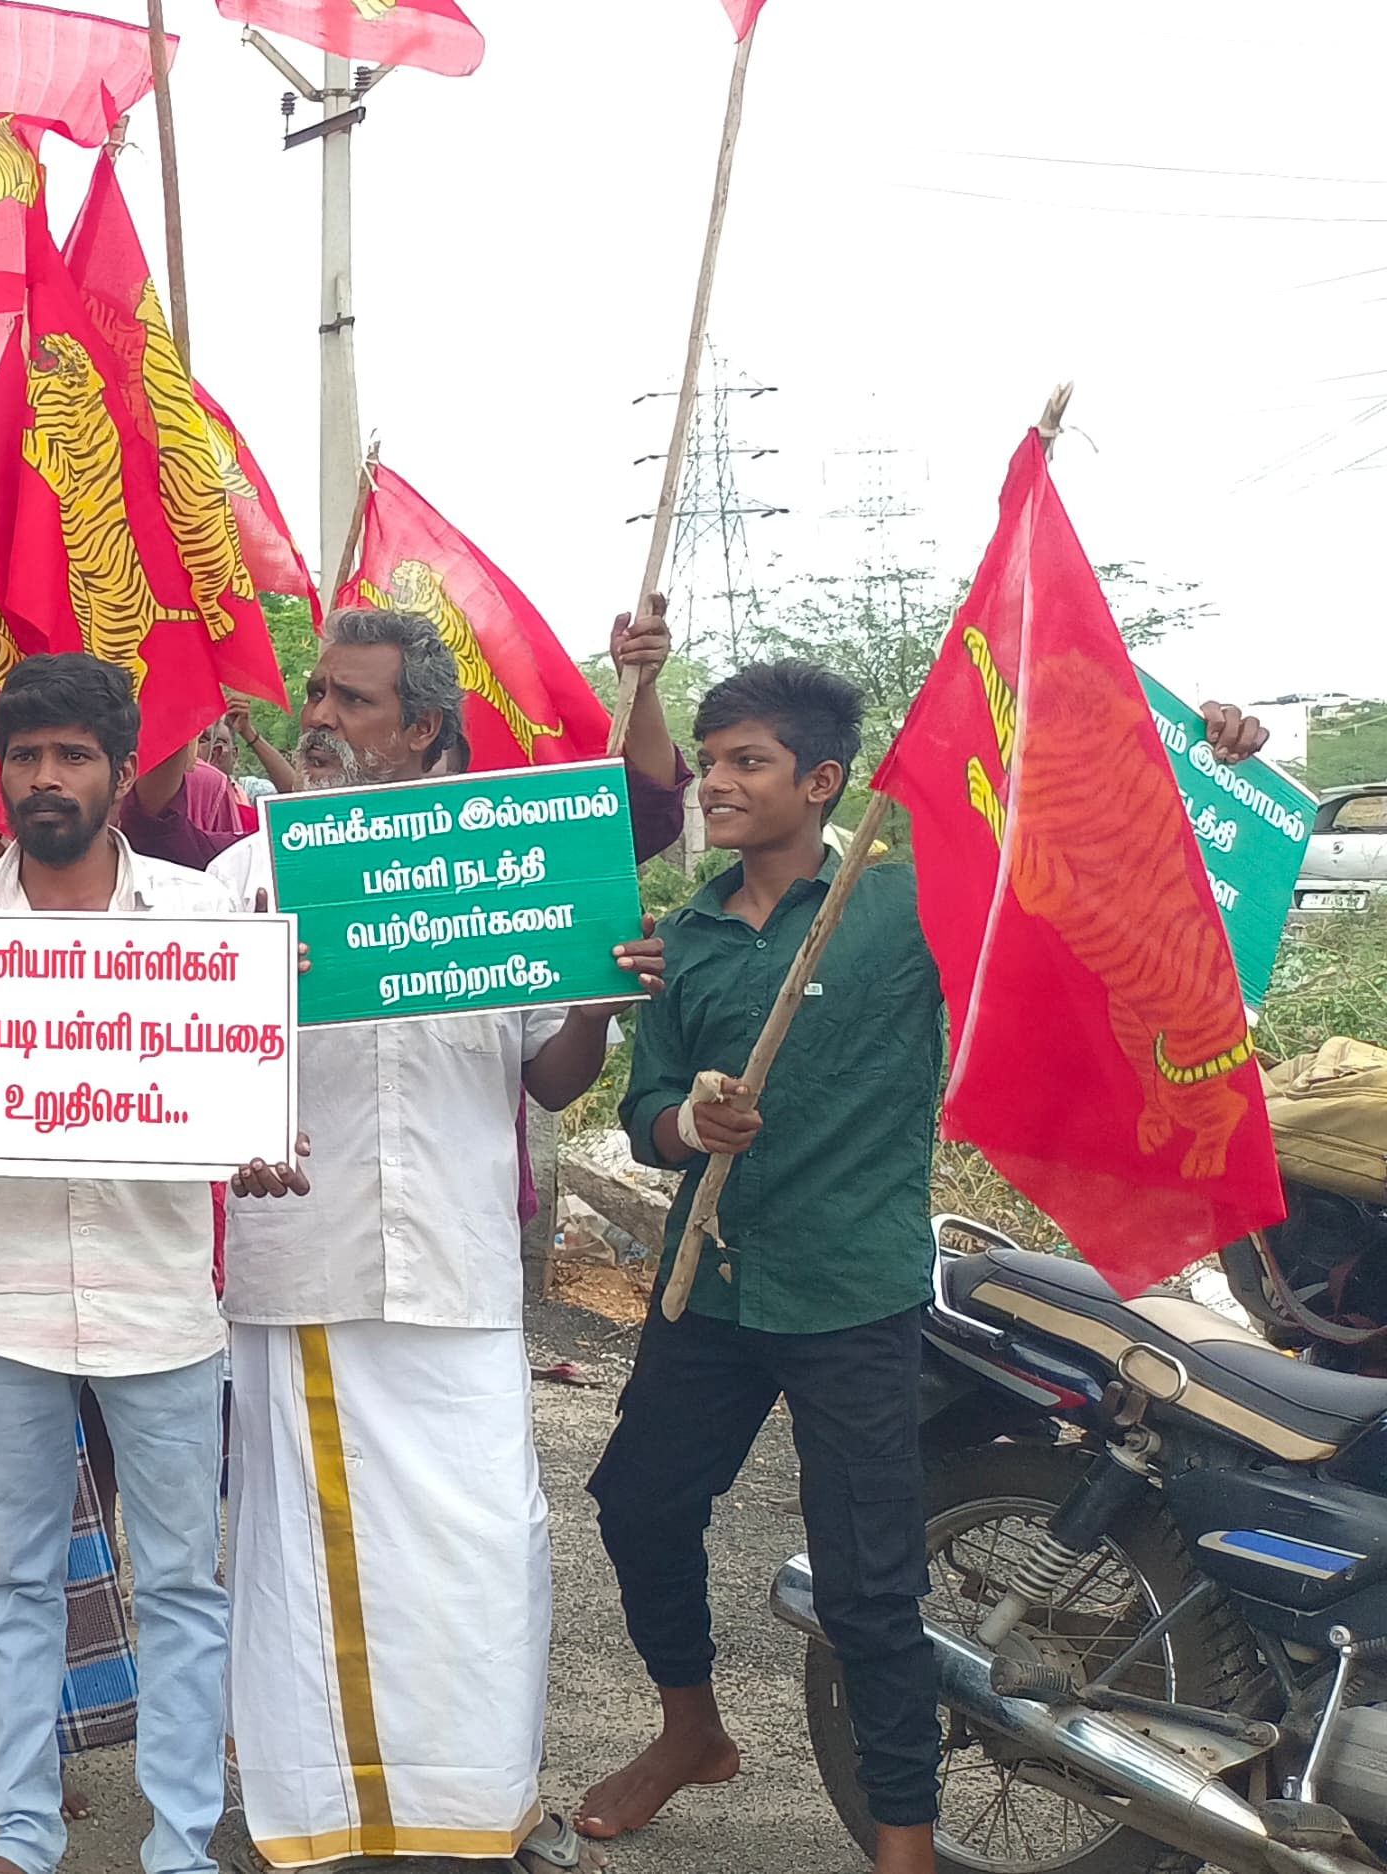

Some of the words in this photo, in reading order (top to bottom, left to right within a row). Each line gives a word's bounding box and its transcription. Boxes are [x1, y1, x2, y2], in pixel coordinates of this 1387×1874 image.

[282, 804, 452, 850] அங்கீகாரம்
[459, 787, 618, 830] இல்லாமல்
[1179, 790, 1237, 853] டத்தி
[364, 858, 447, 893] பள்ளி
[454, 847, 545, 892] நடத்தி
[347, 905, 573, 950] பெற்றோர்களை
[94, 940, 239, 982] பள்ளிகள்
[380, 955, 559, 1004] ஏமாற்றாதே.
[45, 1010, 132, 1051] பள்ளி
[140, 1012, 285, 1062] நடப்பதை
[5, 1082, 188, 1134] உறுதிசெய்...
